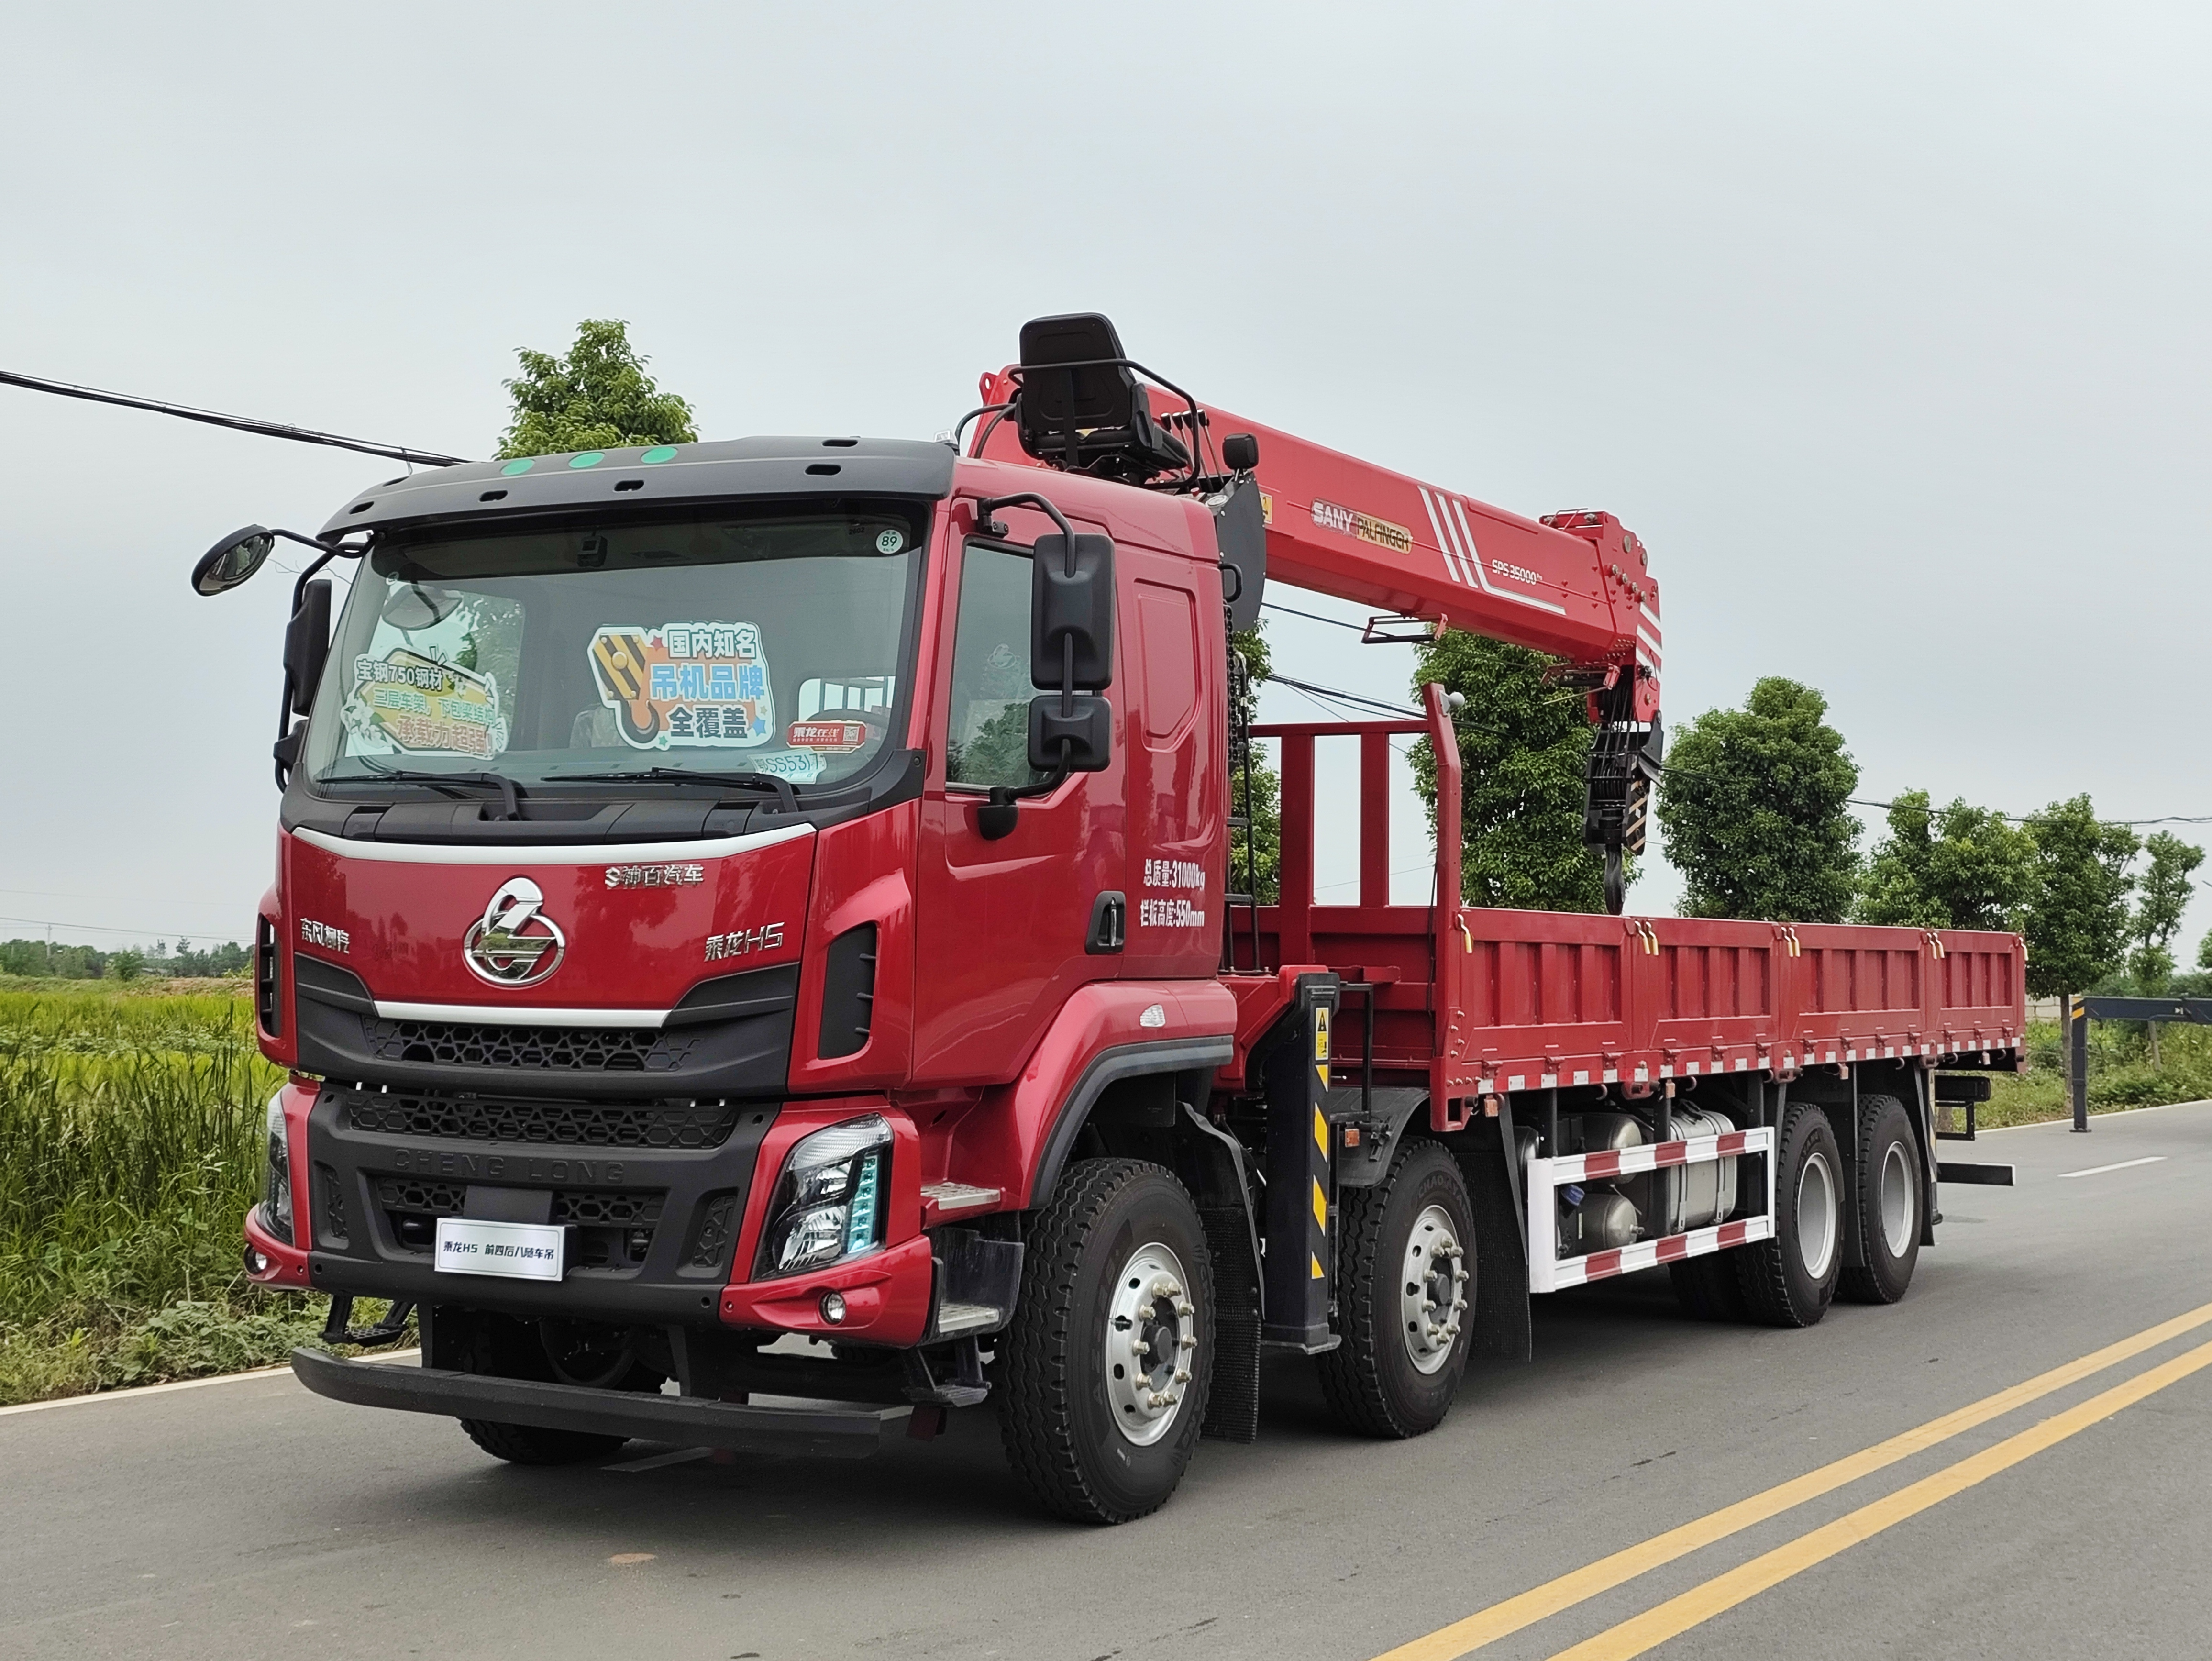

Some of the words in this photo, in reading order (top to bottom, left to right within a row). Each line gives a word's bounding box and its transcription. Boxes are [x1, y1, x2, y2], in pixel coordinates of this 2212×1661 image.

[881, 536, 897, 546] 89
[1313, 502, 1353, 532] SANY
[1357, 517, 1409, 552] PALFINGER
[1492, 559, 1509, 576] SPS
[1510, 565, 1537, 585] 35000
[670, 629, 757, 659] 国内知名
[356, 659, 443, 691] 宝钢750钢材
[650, 663, 765, 701] 吊机品牌
[668, 707, 748, 739] 全覆盖
[1143, 858, 1206, 891] 总质量:31000kg
[1140, 898, 1205, 928] 栏板高度:550mm
[703, 921, 785, 962] 乘龙H5
[394, 1149, 504, 1178] CHENG
[528, 1158, 624, 1185] LONG
[443, 1241, 478, 1253] 乘龙H5
[484, 1244, 555, 1260] 前四后八随车吊
